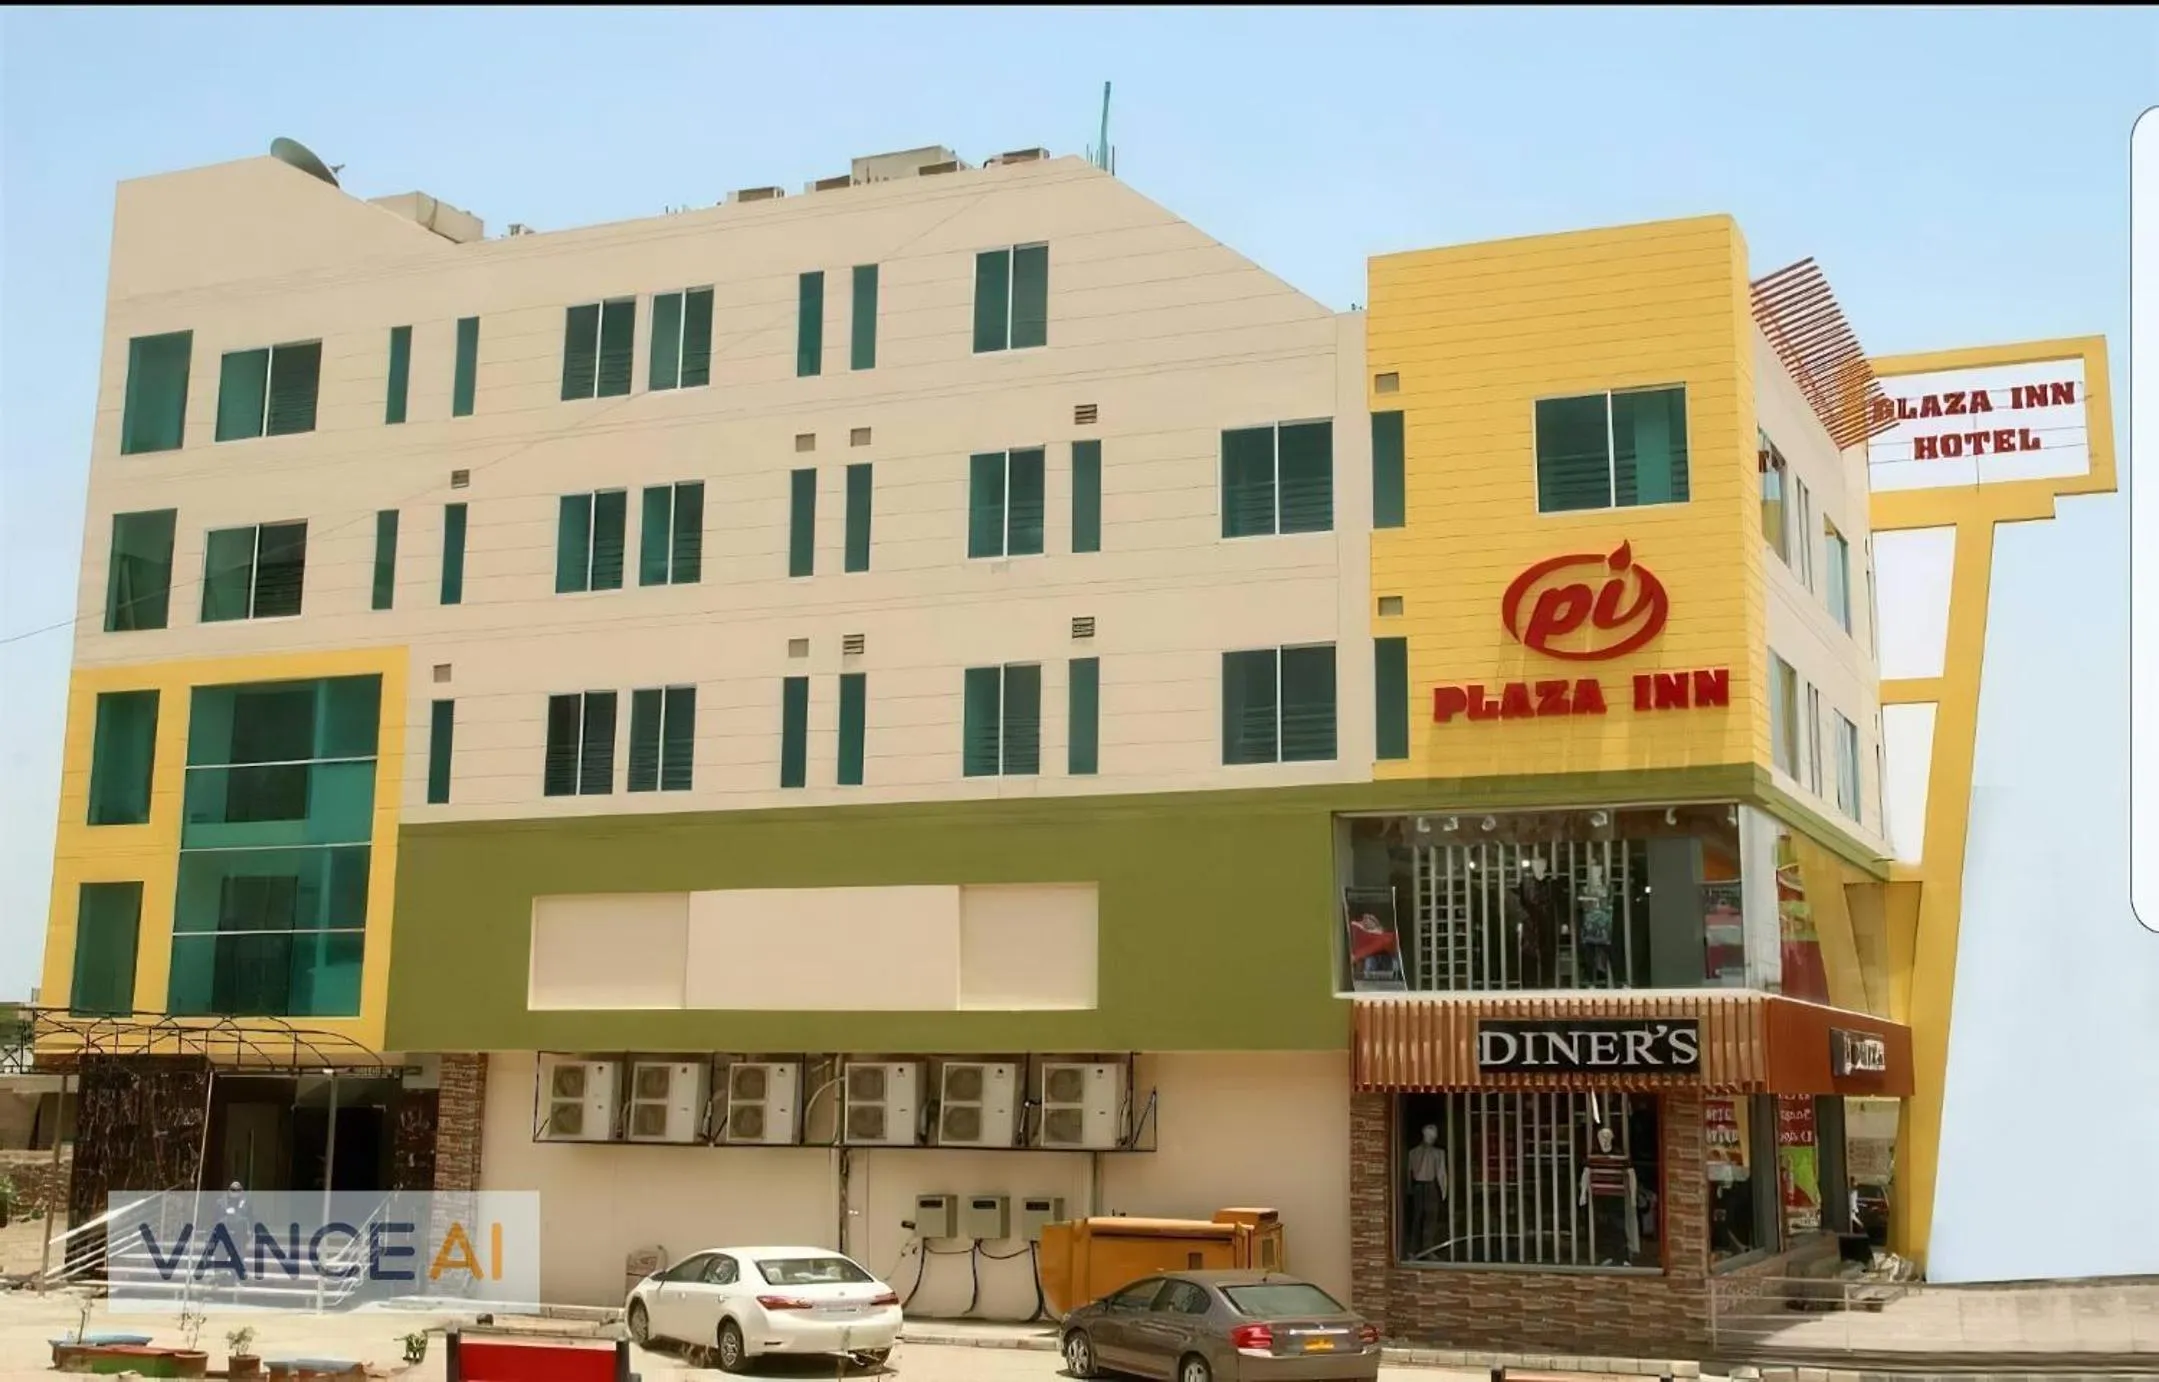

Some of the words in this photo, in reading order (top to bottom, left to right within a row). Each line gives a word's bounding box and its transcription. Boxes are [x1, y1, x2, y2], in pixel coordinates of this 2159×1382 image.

[2010, 381, 2075, 410] INN
[1914, 428, 2041, 460] HOTEL
[1433, 678, 1608, 723] PLAZA
[1633, 668, 1729, 711] INN
[1479, 1024, 1698, 1066] DINER'S
